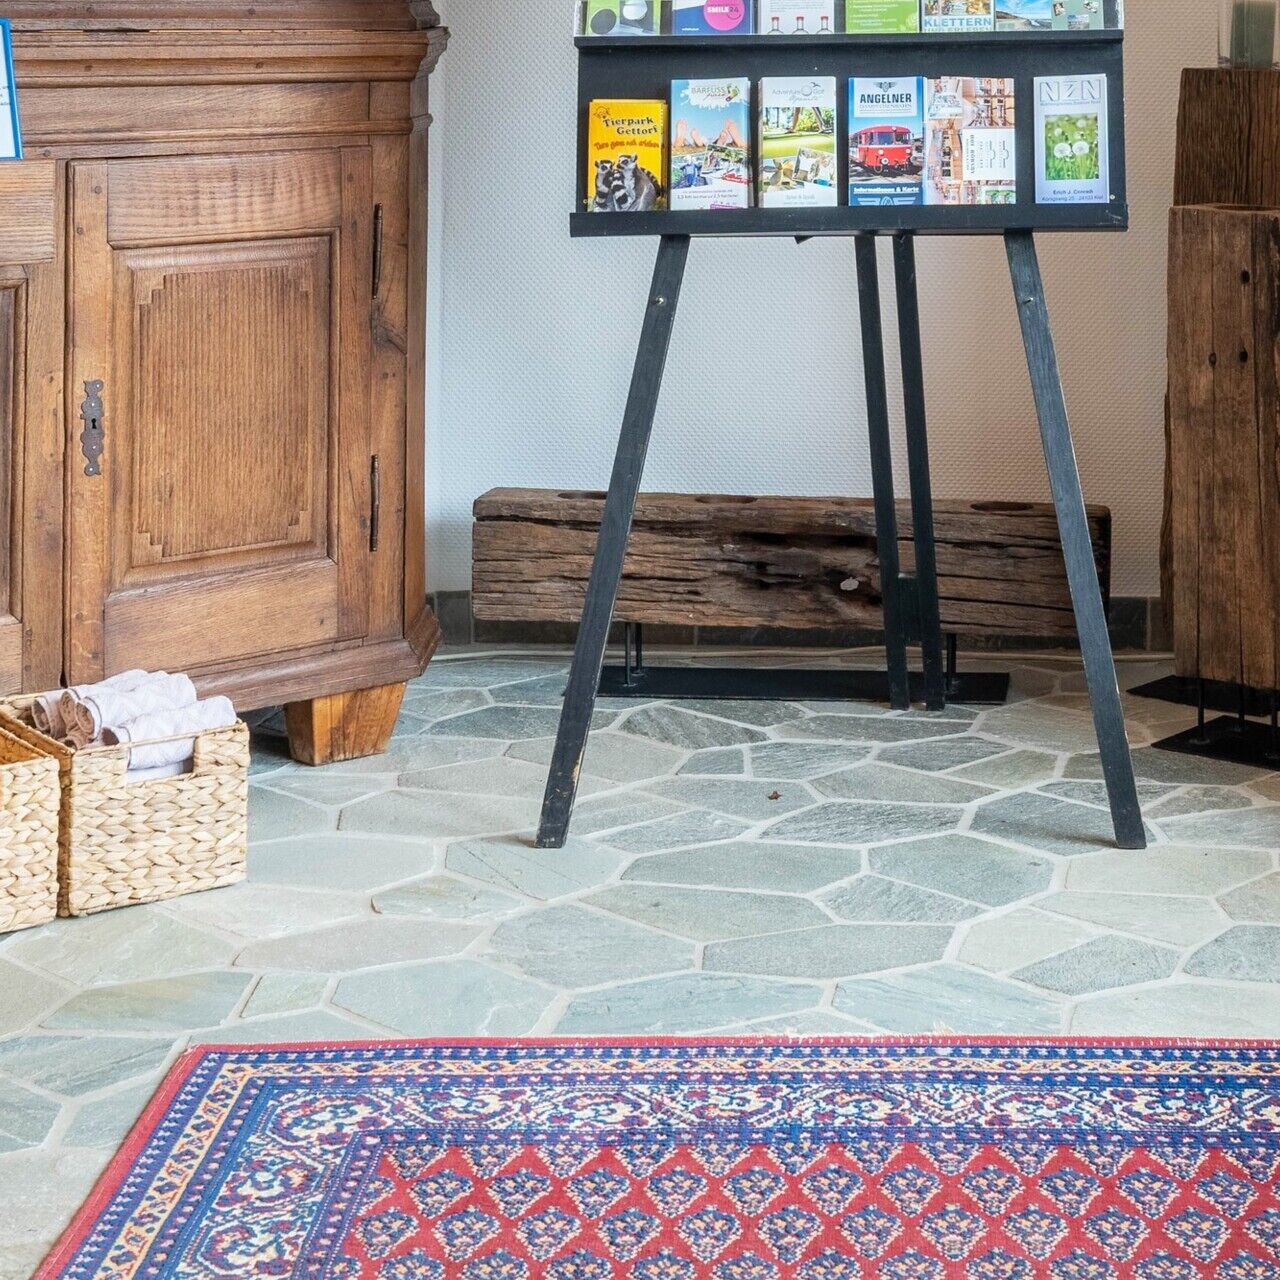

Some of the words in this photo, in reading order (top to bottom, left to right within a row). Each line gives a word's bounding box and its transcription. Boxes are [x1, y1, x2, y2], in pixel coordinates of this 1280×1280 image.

[924, 17, 992, 27] KLETTERN
[859, 93, 912, 104] ANGELNER
[602, 116, 654, 127] Tierpark
[616, 125, 658, 135] Gettorf
